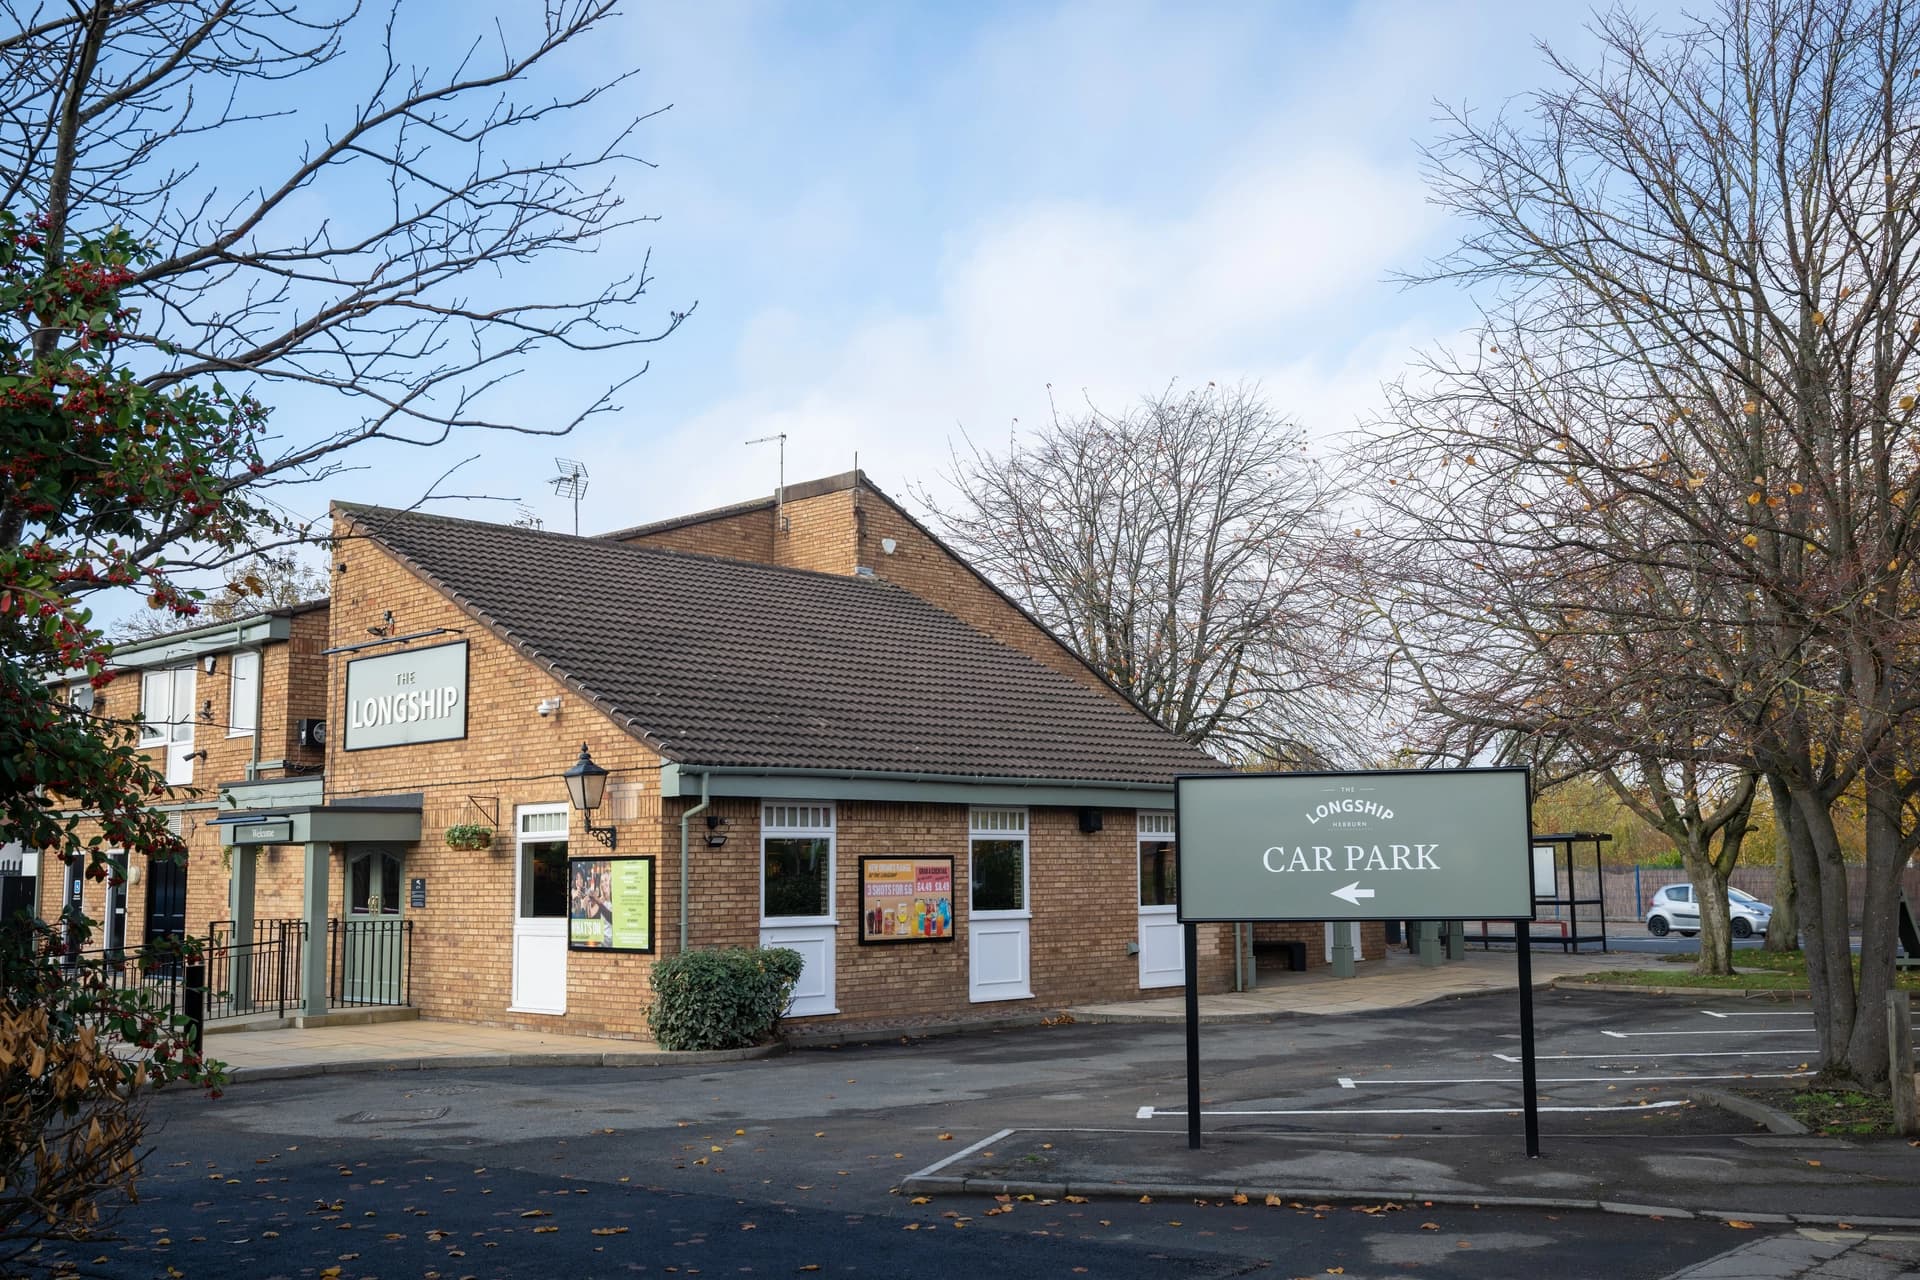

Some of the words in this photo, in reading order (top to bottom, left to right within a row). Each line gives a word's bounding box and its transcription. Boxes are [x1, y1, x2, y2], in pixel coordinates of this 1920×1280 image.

[395, 671, 416, 686] THE
[351, 686, 459, 729] LONGSHIP
[1305, 799, 1394, 824] LONGSHIP
[1262, 846, 1337, 873] CAR
[1343, 843, 1441, 871] PARK
[873, 884, 892, 896] SHOTS
[892, 884, 903, 896] FOR
